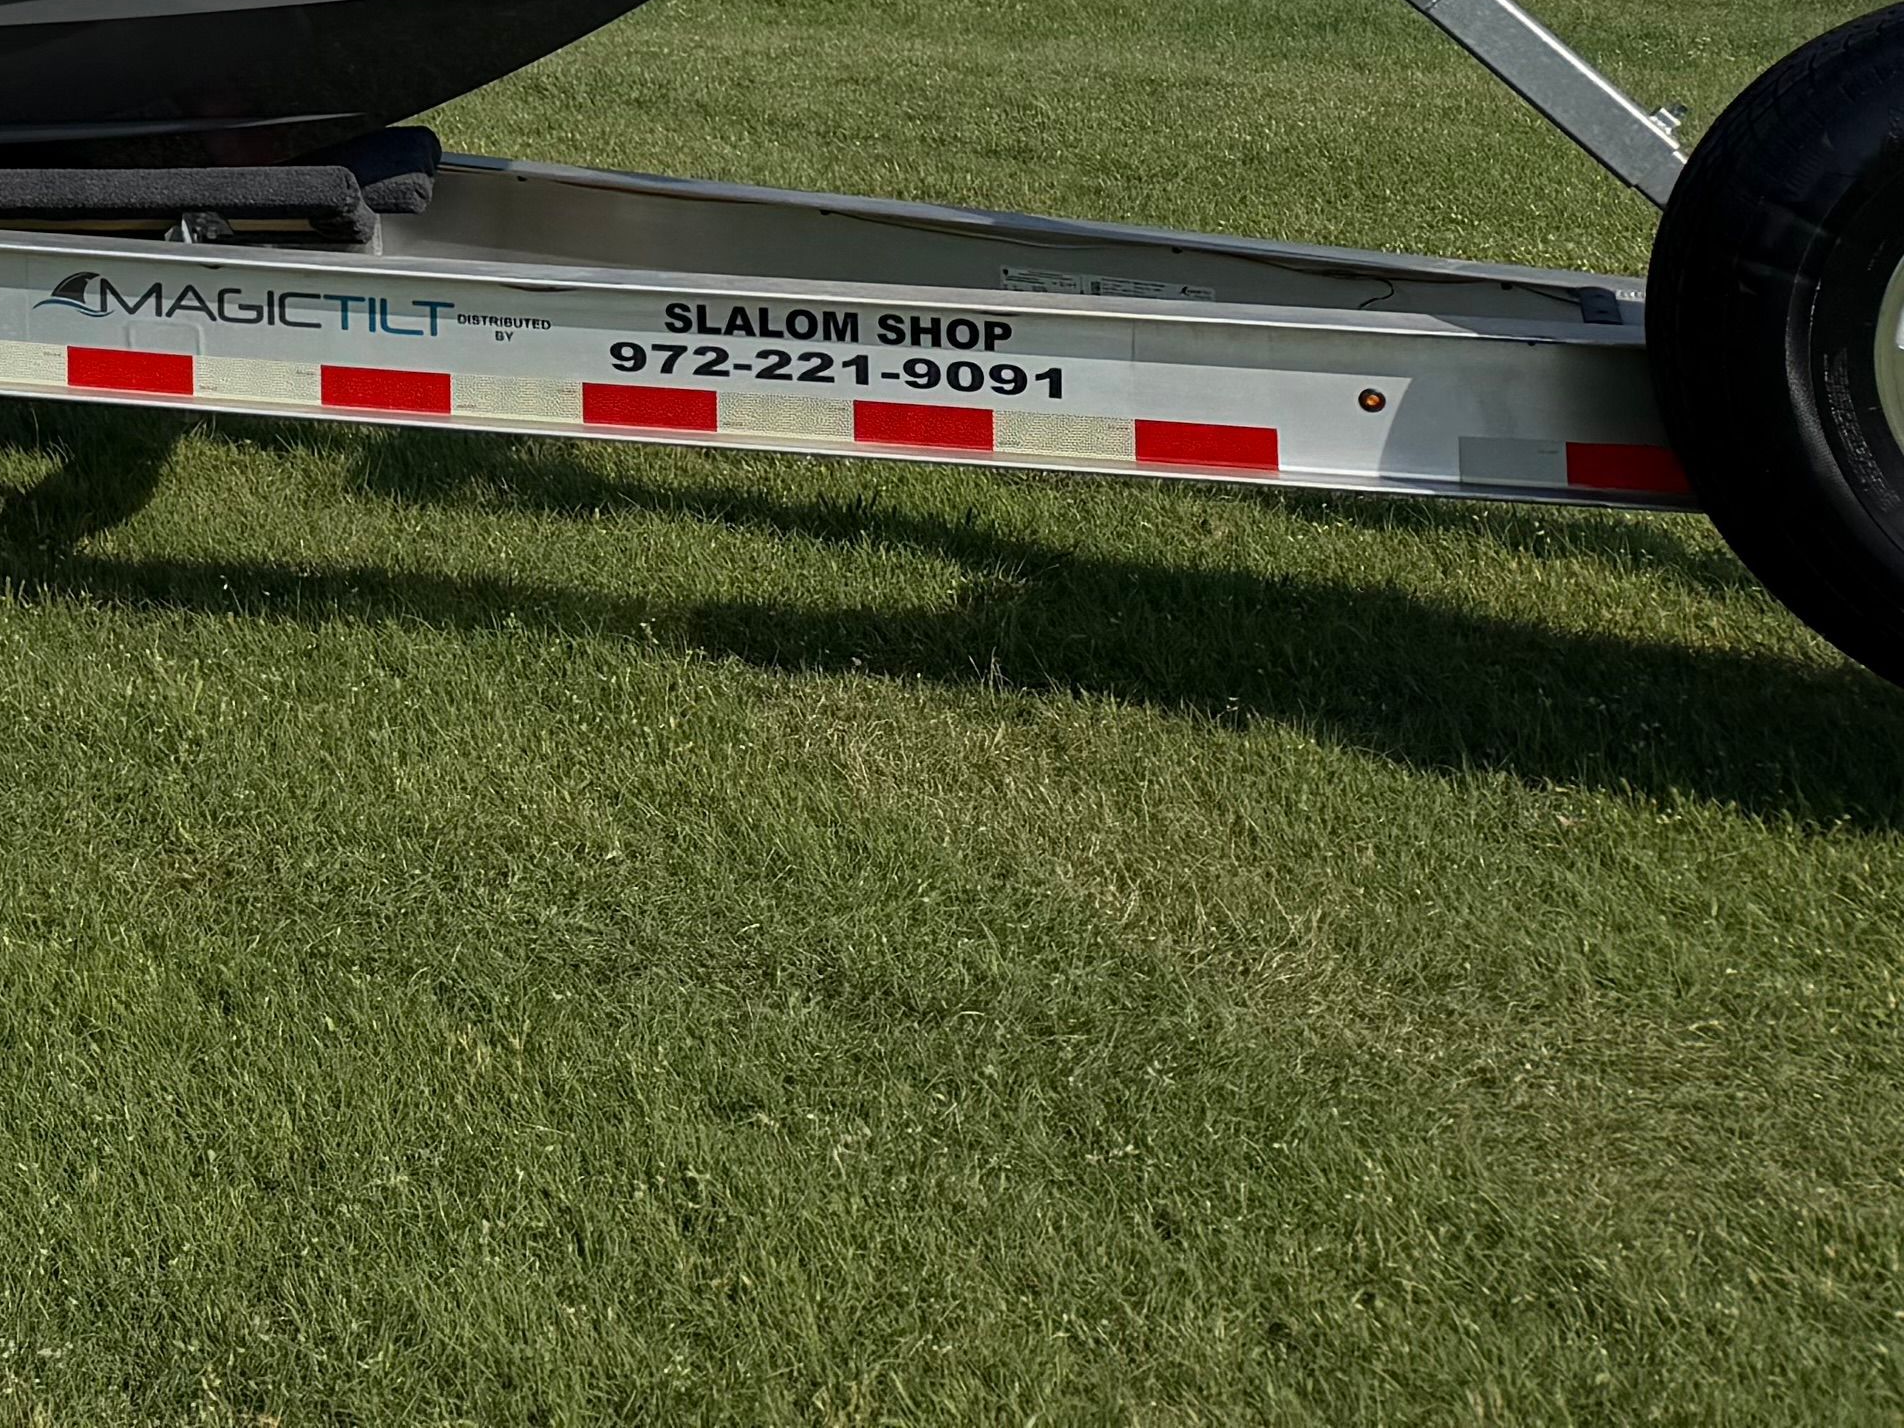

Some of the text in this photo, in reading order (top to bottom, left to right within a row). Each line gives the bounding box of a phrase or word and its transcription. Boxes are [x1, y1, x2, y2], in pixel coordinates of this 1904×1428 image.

[99, 276, 456, 337] MAGICTILT
[457, 313, 552, 330] DISTRIBUTED
[664, 302, 1013, 351] SLALOM SHOP
[495, 330, 514, 342] BY
[608, 340, 1064, 400] 972-221-9091
